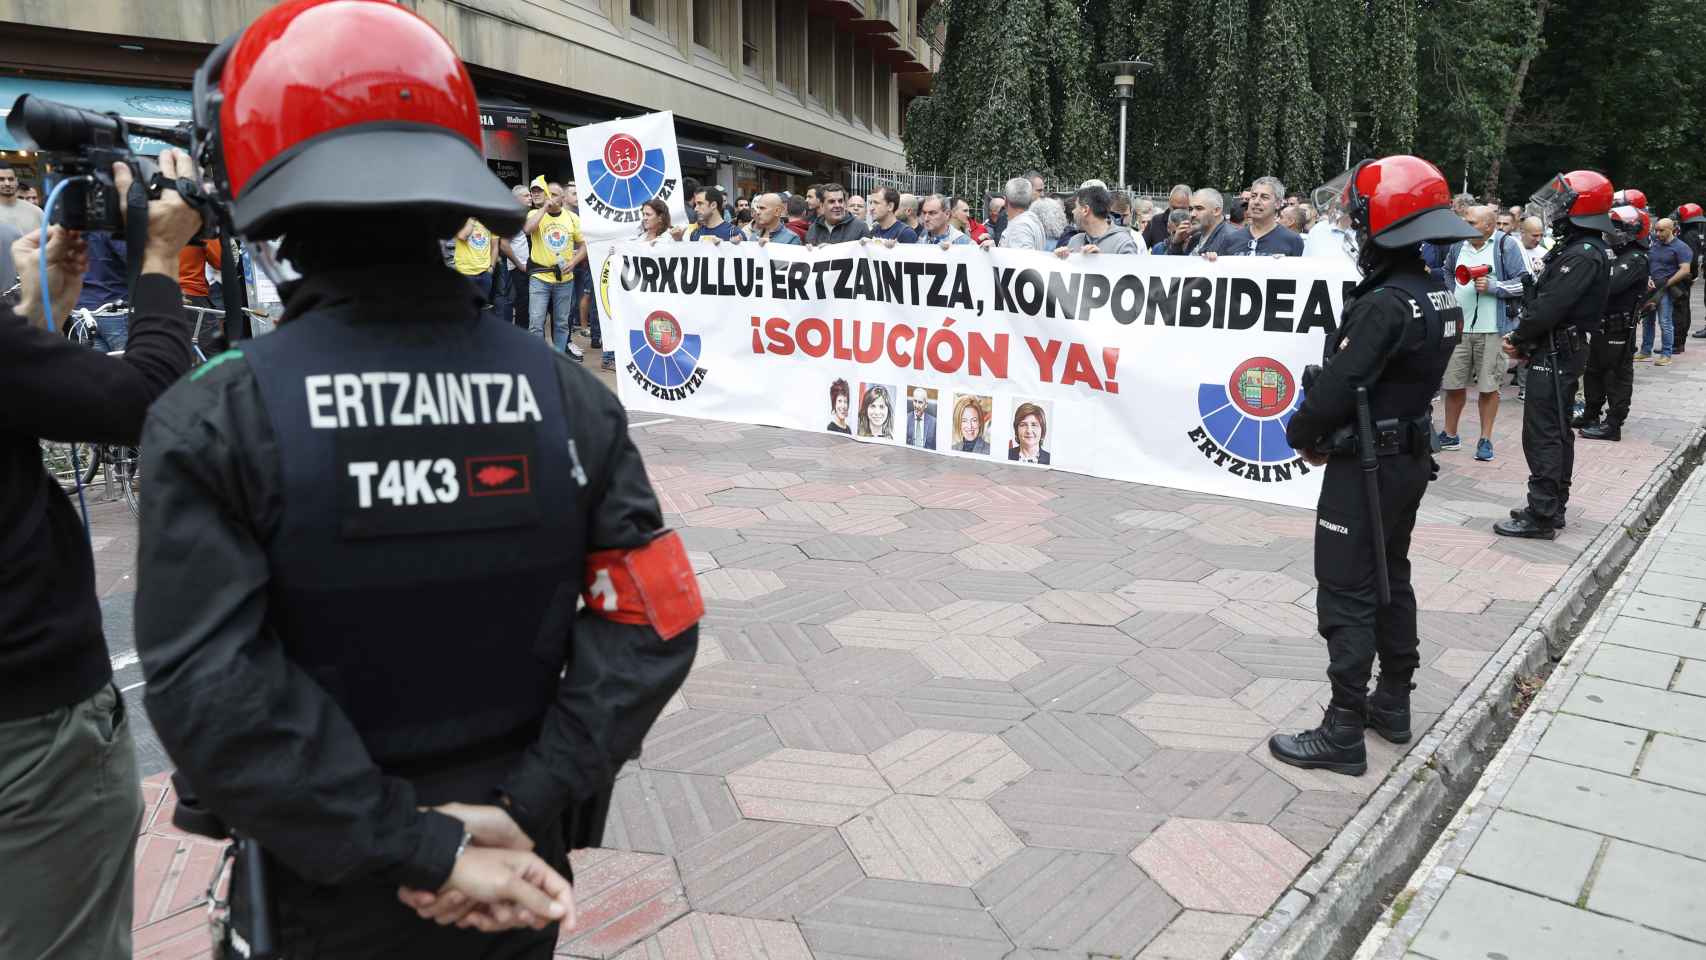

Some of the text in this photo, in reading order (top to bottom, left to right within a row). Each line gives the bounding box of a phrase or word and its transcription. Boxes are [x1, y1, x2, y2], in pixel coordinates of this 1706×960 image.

[585, 178, 677, 224] ERTZAIZA
[620, 255, 763, 298] URXULLU:
[770, 257, 984, 317] ERTZAINTZA,
[626, 359, 709, 401] ERTZAINTZA
[751, 316, 1121, 394] ¡SOLUCIÓN YA!
[305, 372, 542, 429] ERTZAINTZA
[347, 457, 460, 508] T4K3
